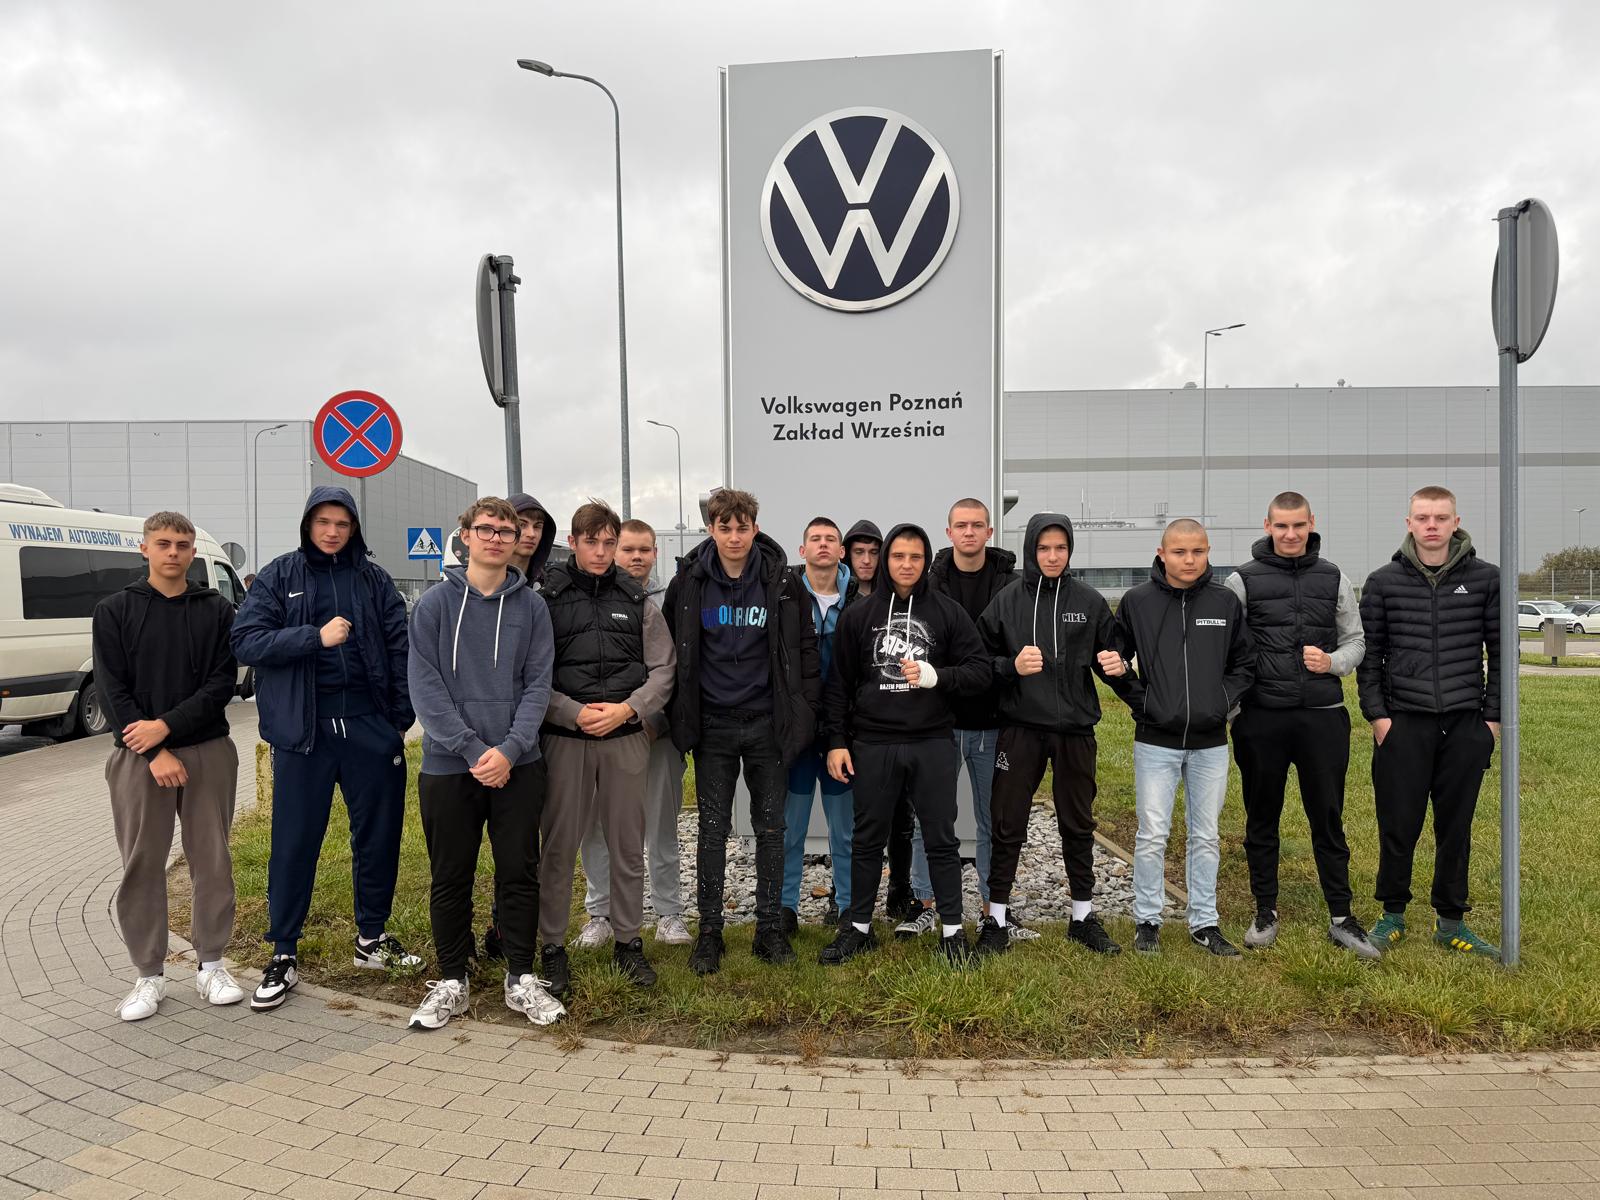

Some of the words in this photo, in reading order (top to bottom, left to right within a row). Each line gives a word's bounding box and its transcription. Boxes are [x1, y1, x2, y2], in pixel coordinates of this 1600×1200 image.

[760, 395, 882, 418] Volkswagen
[889, 391, 963, 411] Poznań
[772, 422, 844, 441] Zakład
[850, 420, 945, 439] Września
[8, 523, 64, 542] WYNAJEM
[68, 529, 122, 546] AUTOBUSÓW
